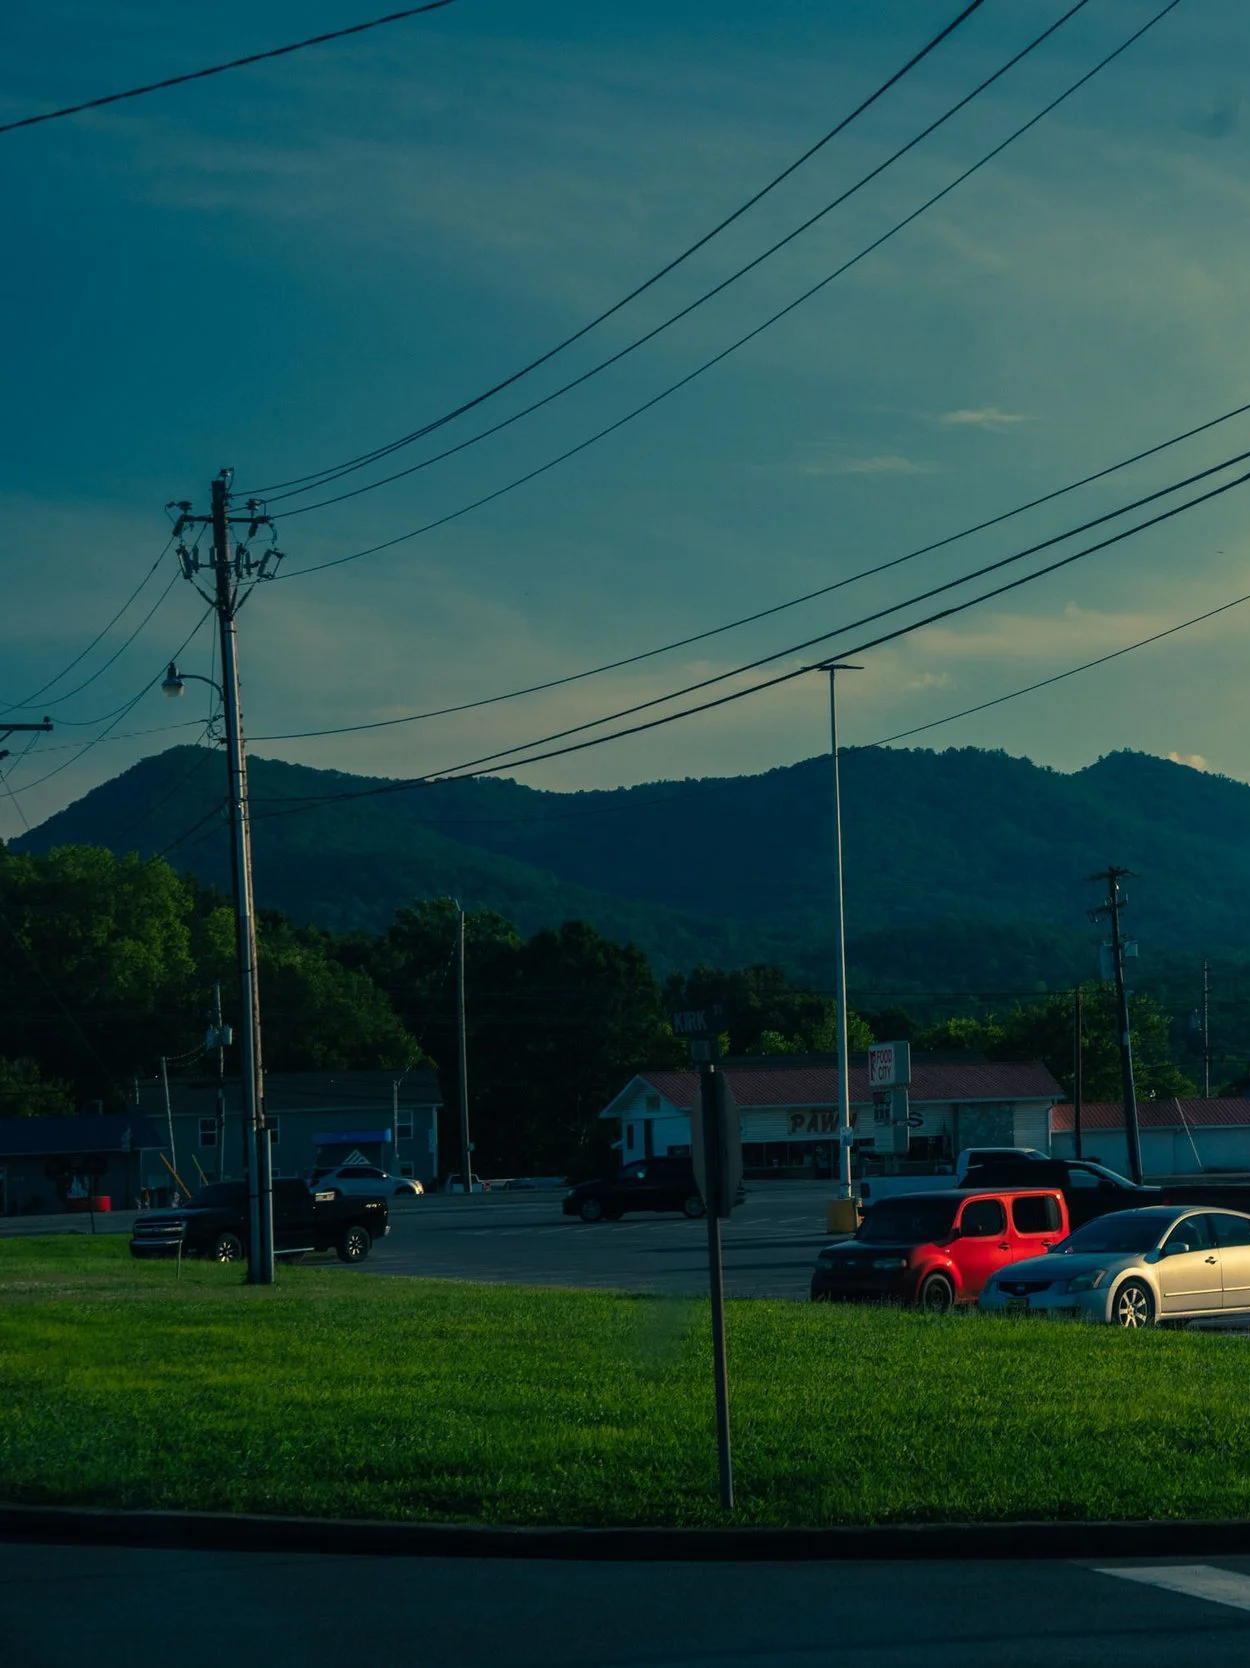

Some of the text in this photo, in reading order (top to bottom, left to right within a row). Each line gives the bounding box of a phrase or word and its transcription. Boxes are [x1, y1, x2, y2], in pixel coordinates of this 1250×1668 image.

[674, 1009, 708, 1033] KIRK
[876, 1048, 893, 1064] FOOD
[878, 1066, 891, 1081] CITY
